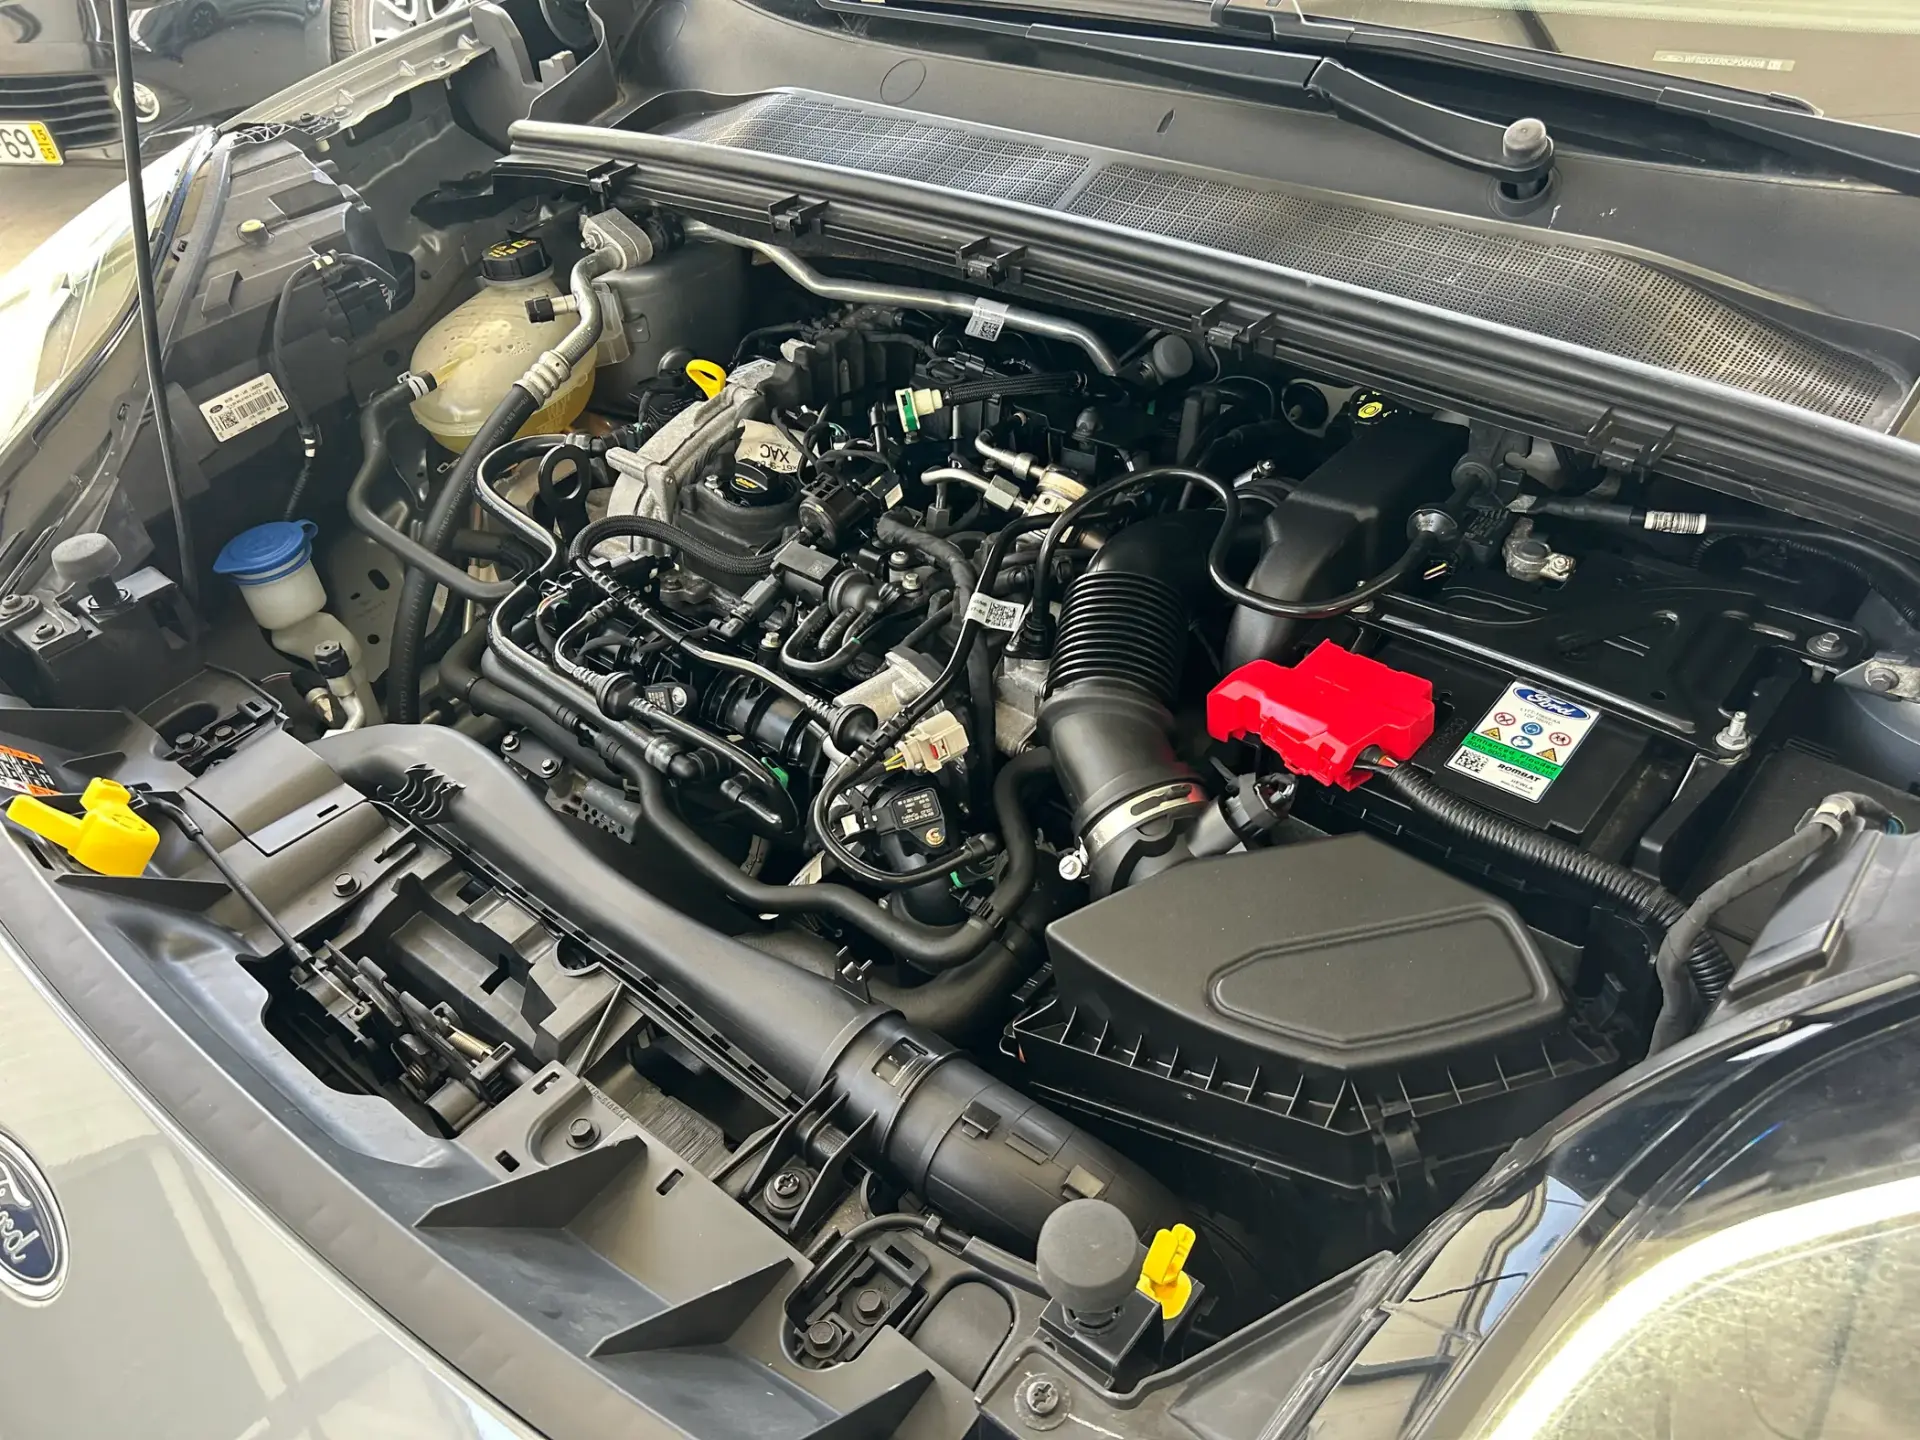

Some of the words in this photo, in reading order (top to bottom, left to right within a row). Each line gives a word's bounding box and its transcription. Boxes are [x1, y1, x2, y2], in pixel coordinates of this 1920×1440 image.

[760, 444, 790, 464] XAC
[1471, 735, 1515, 755] Enhanced
[1520, 754, 1558, 772] Flooded
